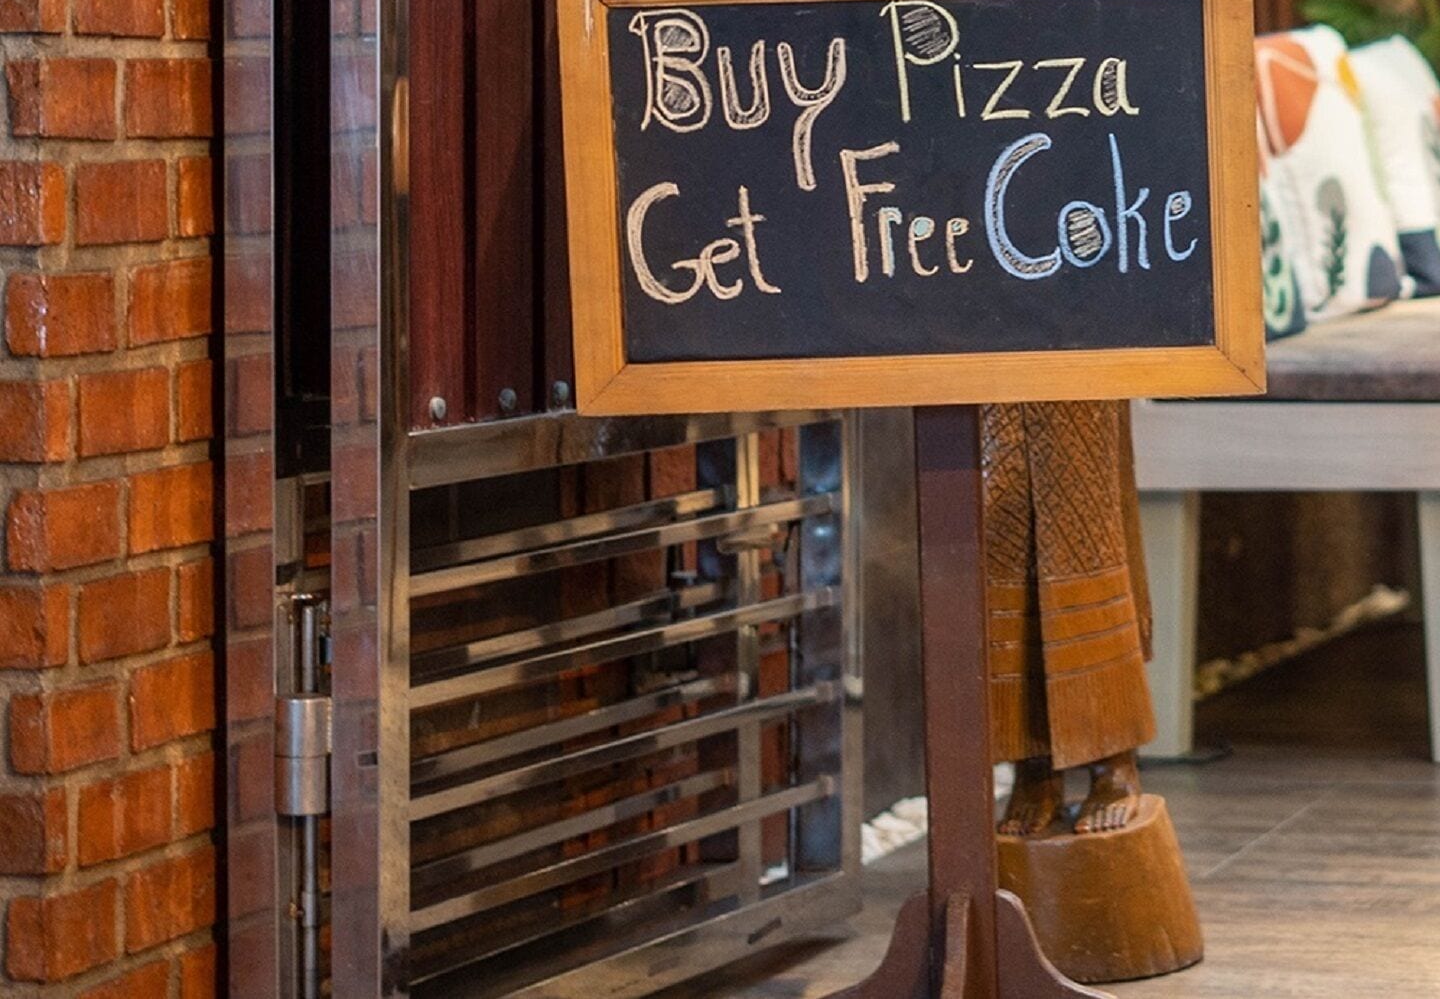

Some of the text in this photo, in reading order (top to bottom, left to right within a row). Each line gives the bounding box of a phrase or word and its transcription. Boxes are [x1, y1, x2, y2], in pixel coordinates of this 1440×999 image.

[879, 0, 1139, 122] Pizza
[627, 132, 1199, 304] Get Free Coke
